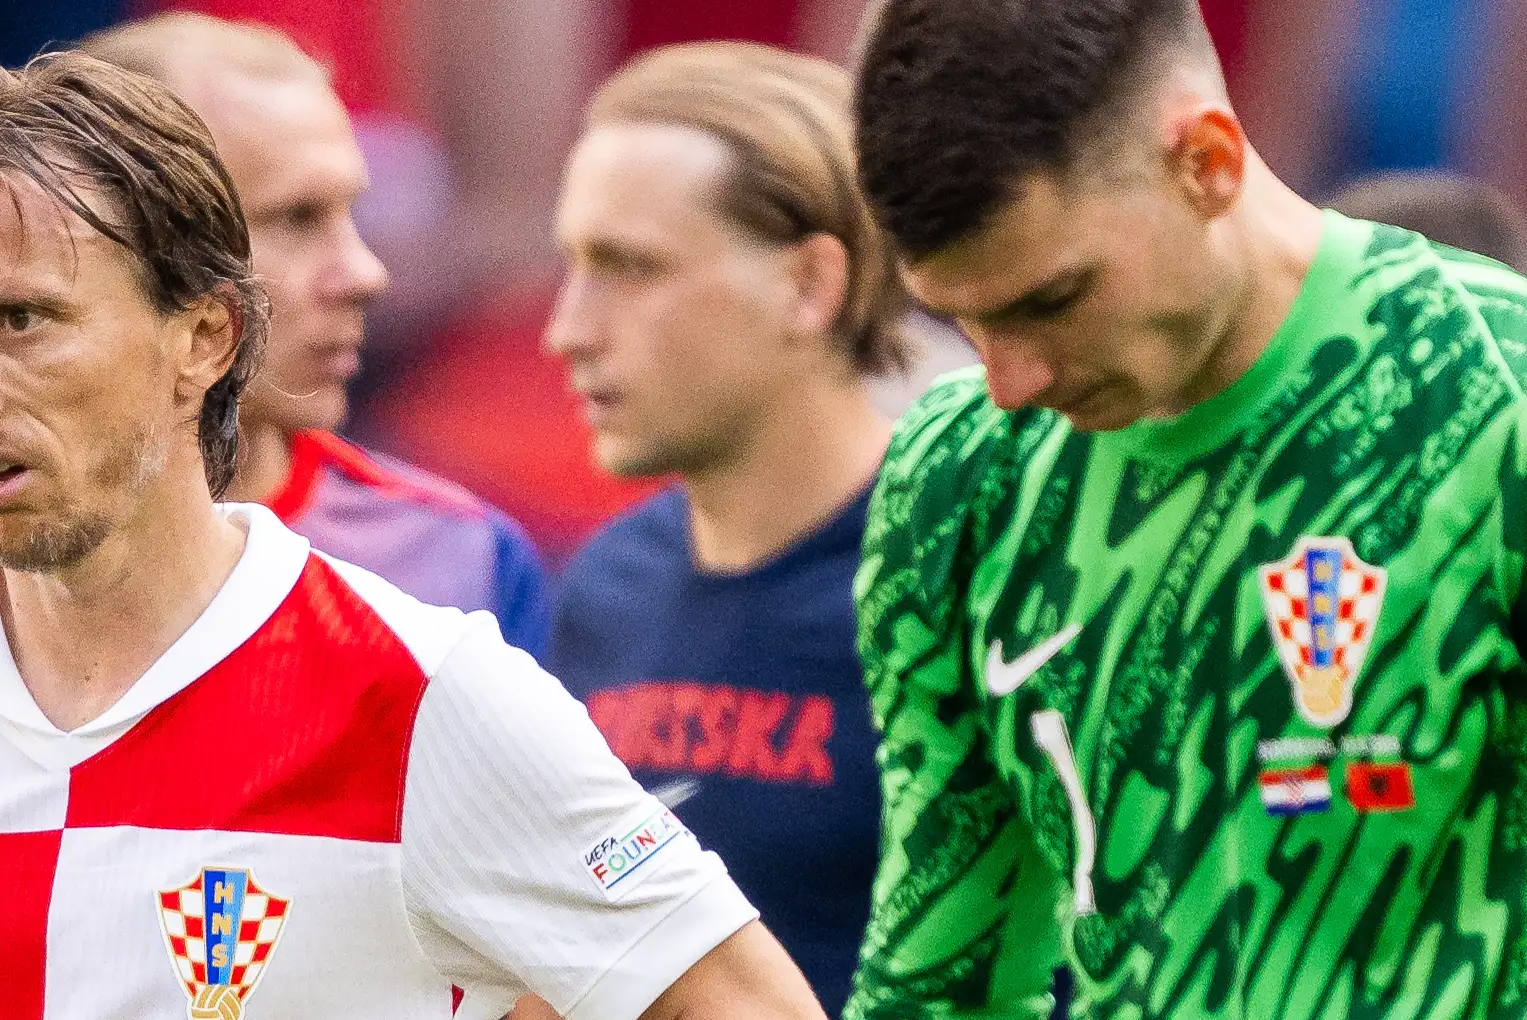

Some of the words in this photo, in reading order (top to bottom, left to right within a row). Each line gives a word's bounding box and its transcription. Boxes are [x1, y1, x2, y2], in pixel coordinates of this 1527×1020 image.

[584, 836, 619, 867] UEFA
[1030, 710, 1097, 915] 1
[212, 881, 234, 968] HNS
